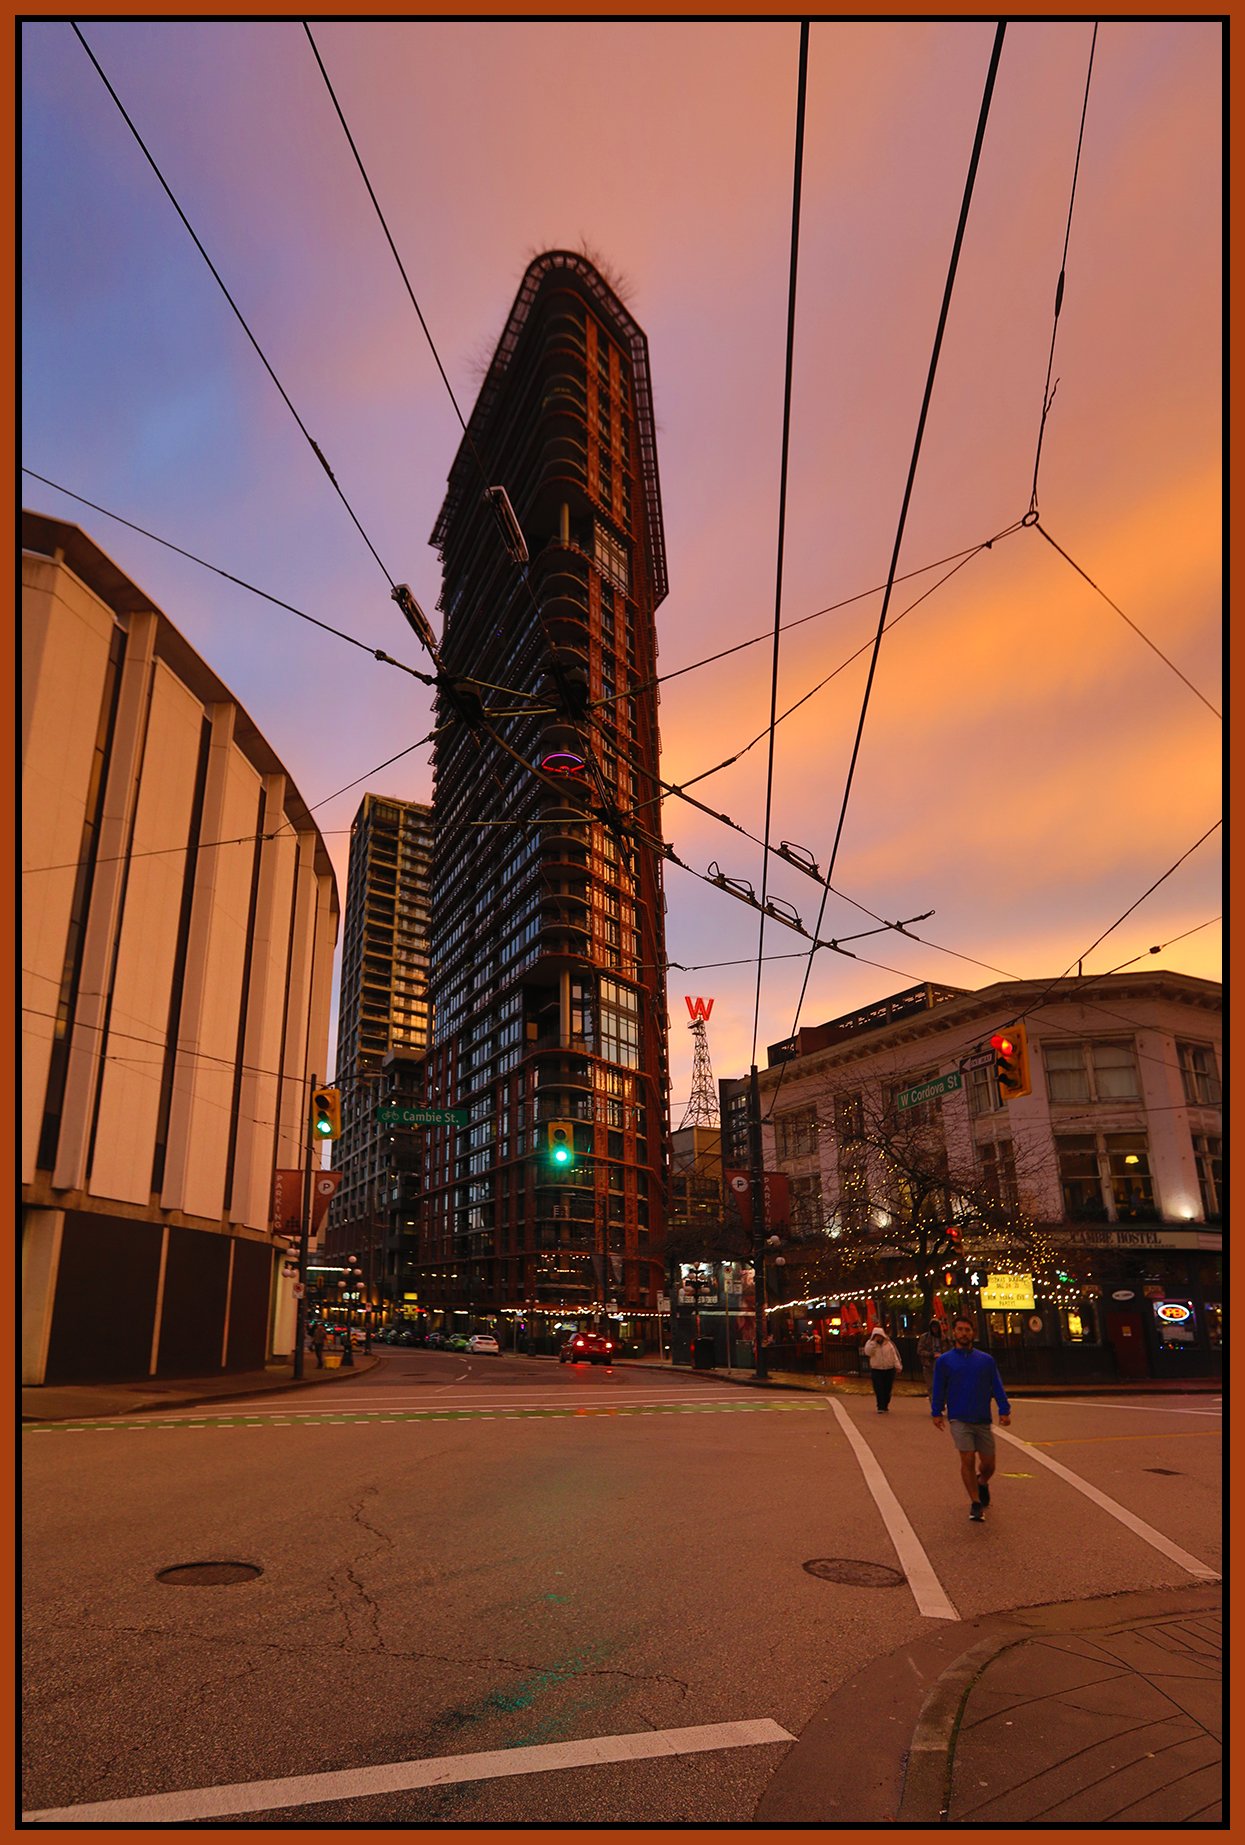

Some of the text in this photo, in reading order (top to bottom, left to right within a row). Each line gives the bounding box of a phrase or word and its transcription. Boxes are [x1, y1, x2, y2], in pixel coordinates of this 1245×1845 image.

[684, 995, 714, 1021] W
[900, 1074, 958, 1106] W Cordova St
[402, 1111, 459, 1123] Cambie St.
[274, 1175, 283, 1229] PARKING
[1117, 1232, 1162, 1245] HOSTEL
[1161, 1307, 1188, 1319] OPEN
